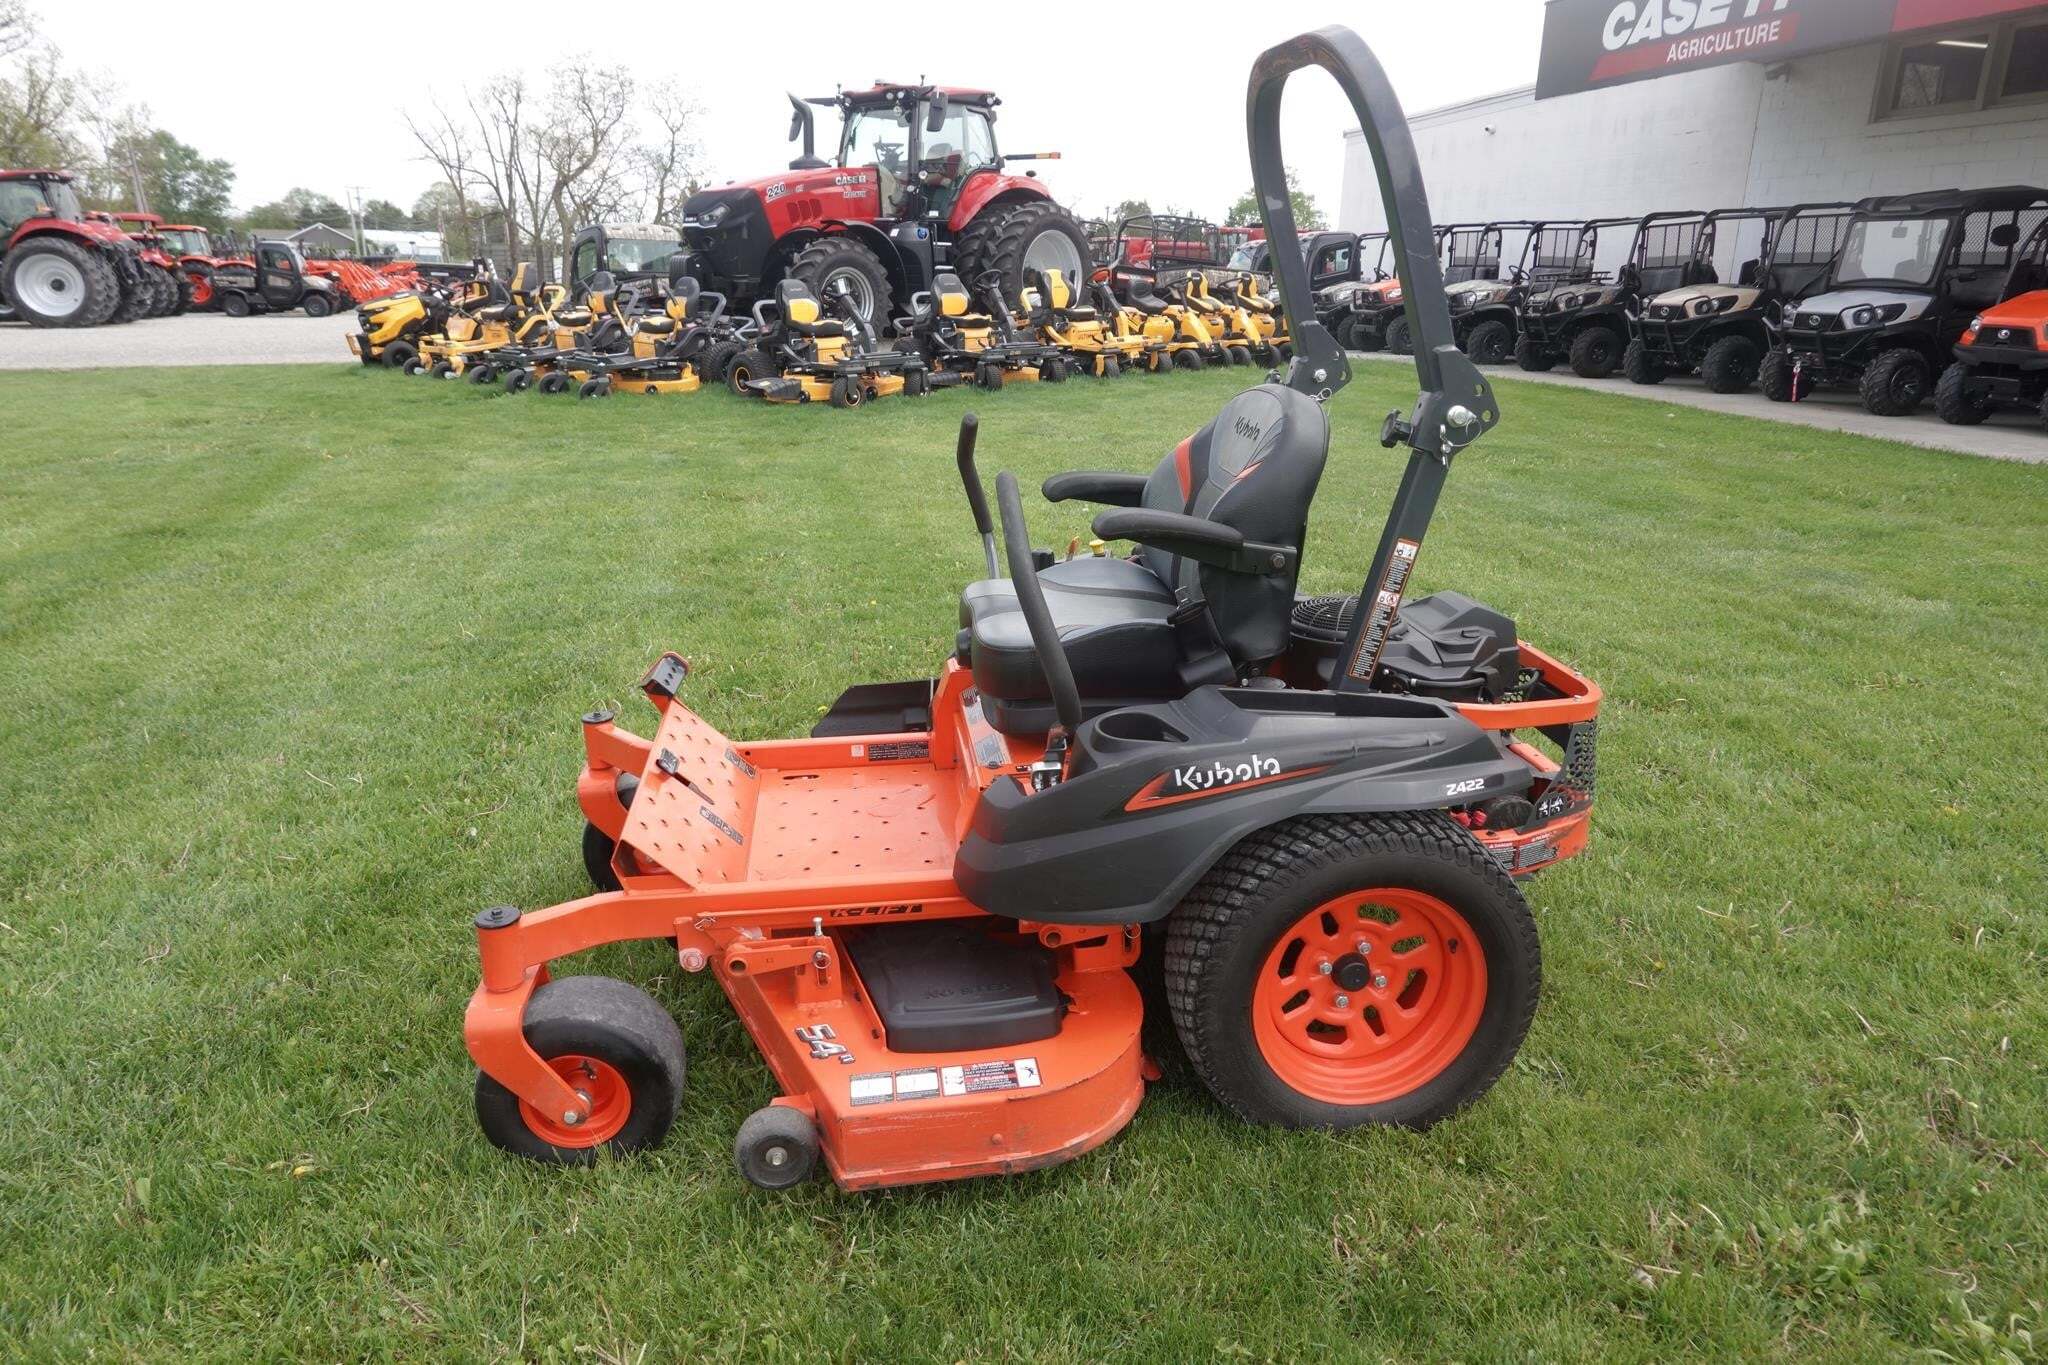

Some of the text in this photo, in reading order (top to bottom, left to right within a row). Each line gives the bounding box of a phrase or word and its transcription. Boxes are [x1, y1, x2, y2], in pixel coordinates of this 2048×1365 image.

[1602, 0, 1732, 50] CASE
[1667, 20, 1782, 63] AGRICULTURE
[767, 183, 786, 198] 220
[1234, 416, 1260, 440] Kubota
[1175, 754, 1280, 790] Kubota
[1446, 778, 1485, 796] Z422
